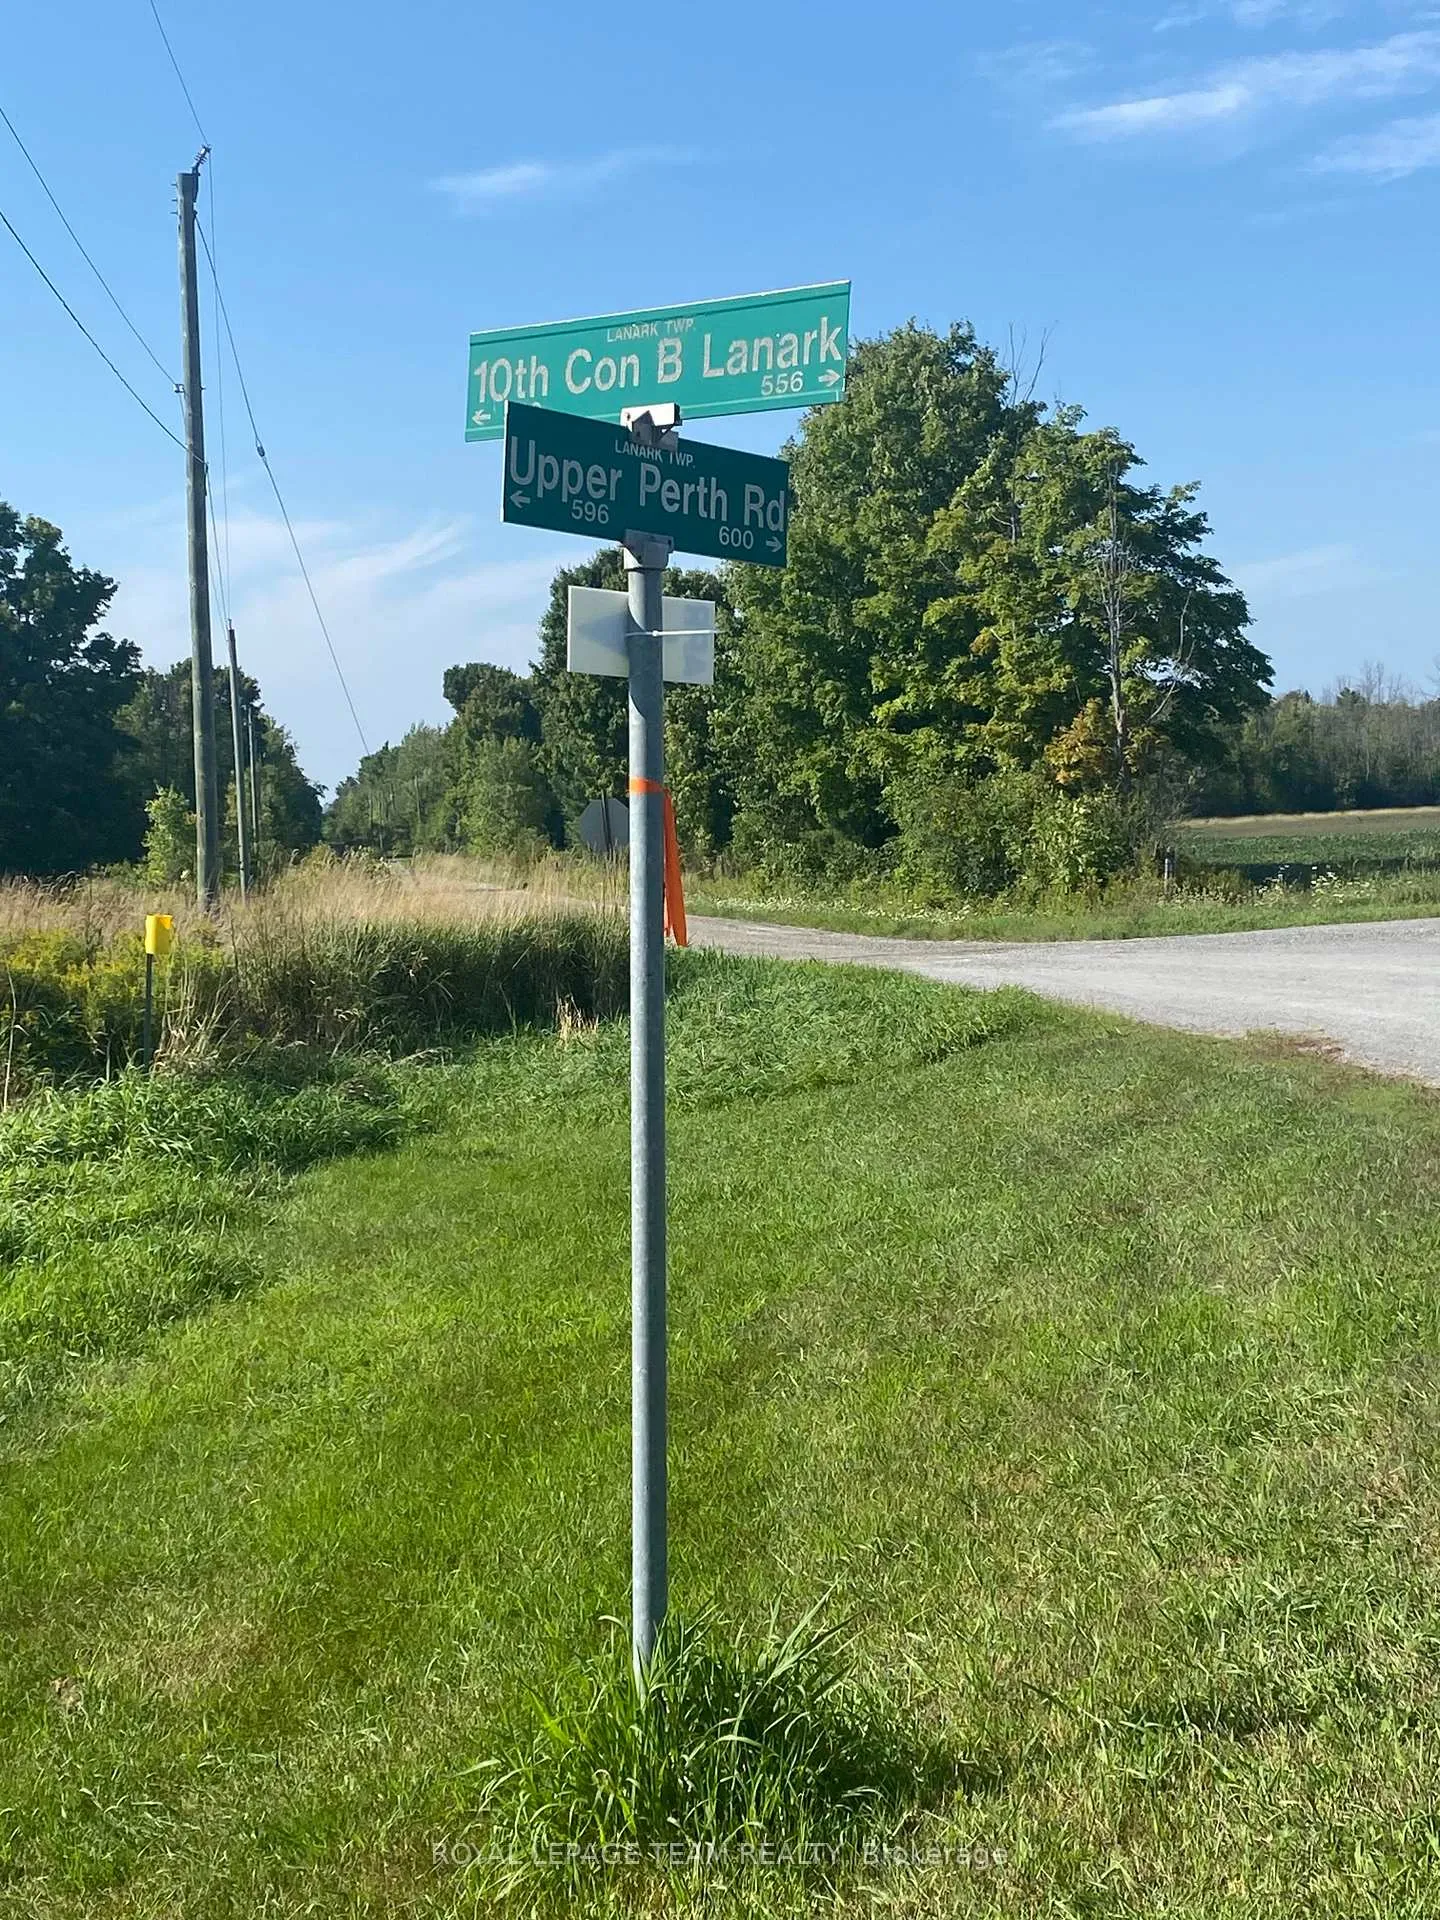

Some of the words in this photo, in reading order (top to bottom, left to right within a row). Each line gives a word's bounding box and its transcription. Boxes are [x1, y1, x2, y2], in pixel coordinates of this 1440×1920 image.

[606, 321, 660, 343] LANARK
[475, 355, 549, 403] 10th
[564, 348, 641, 394] Con
[657, 338, 683, 385] B
[703, 316, 843, 378] Lanark
[760, 372, 805, 396] 556
[614, 439, 664, 463] LANARK
[511, 436, 623, 502] Upper
[640, 462, 728, 522] Perth
[744, 484, 786, 533] Rd
[571, 499, 610, 525] 596
[719, 526, 755, 550] 600
